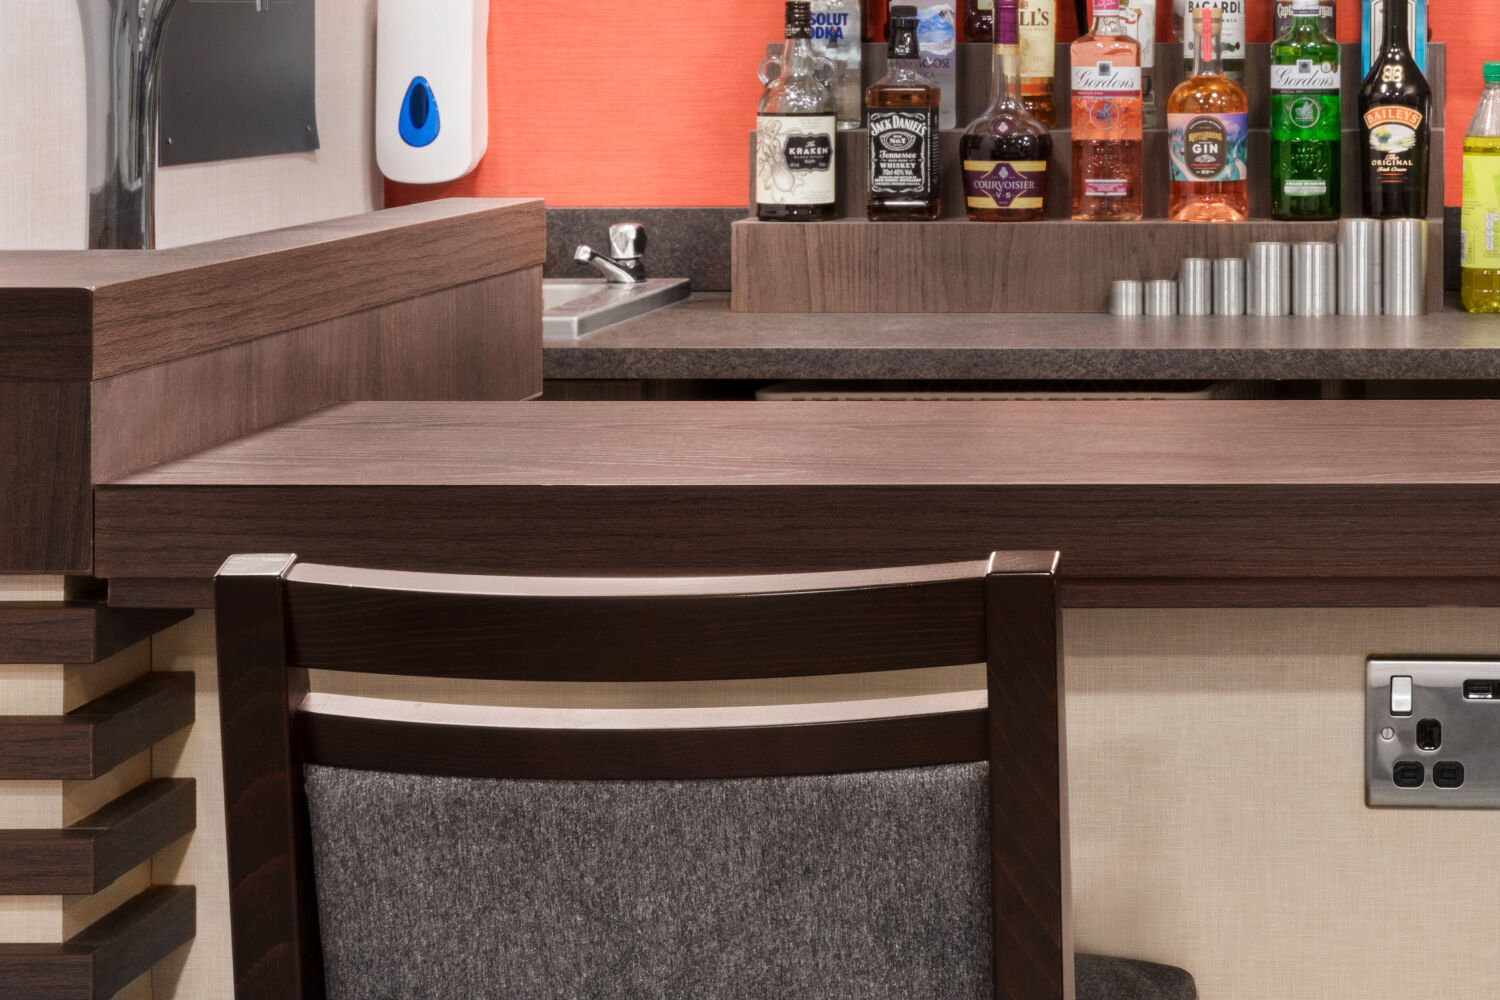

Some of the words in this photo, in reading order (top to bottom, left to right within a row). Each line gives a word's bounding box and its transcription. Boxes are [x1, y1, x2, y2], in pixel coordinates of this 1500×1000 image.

[809, 12, 849, 27] SOLUT
[1018, 8, 1049, 26] LL'S
[810, 26, 844, 40] ODKA
[1366, 109, 1419, 125] BAILEYS
[870, 119, 893, 137] JACK
[892, 114, 928, 136] DANIEL'S
[788, 147, 829, 155] KRAKEN
[879, 149, 917, 159] Tennessee
[1192, 143, 1219, 154] GIN
[973, 180, 1035, 191] COURVOISIER
